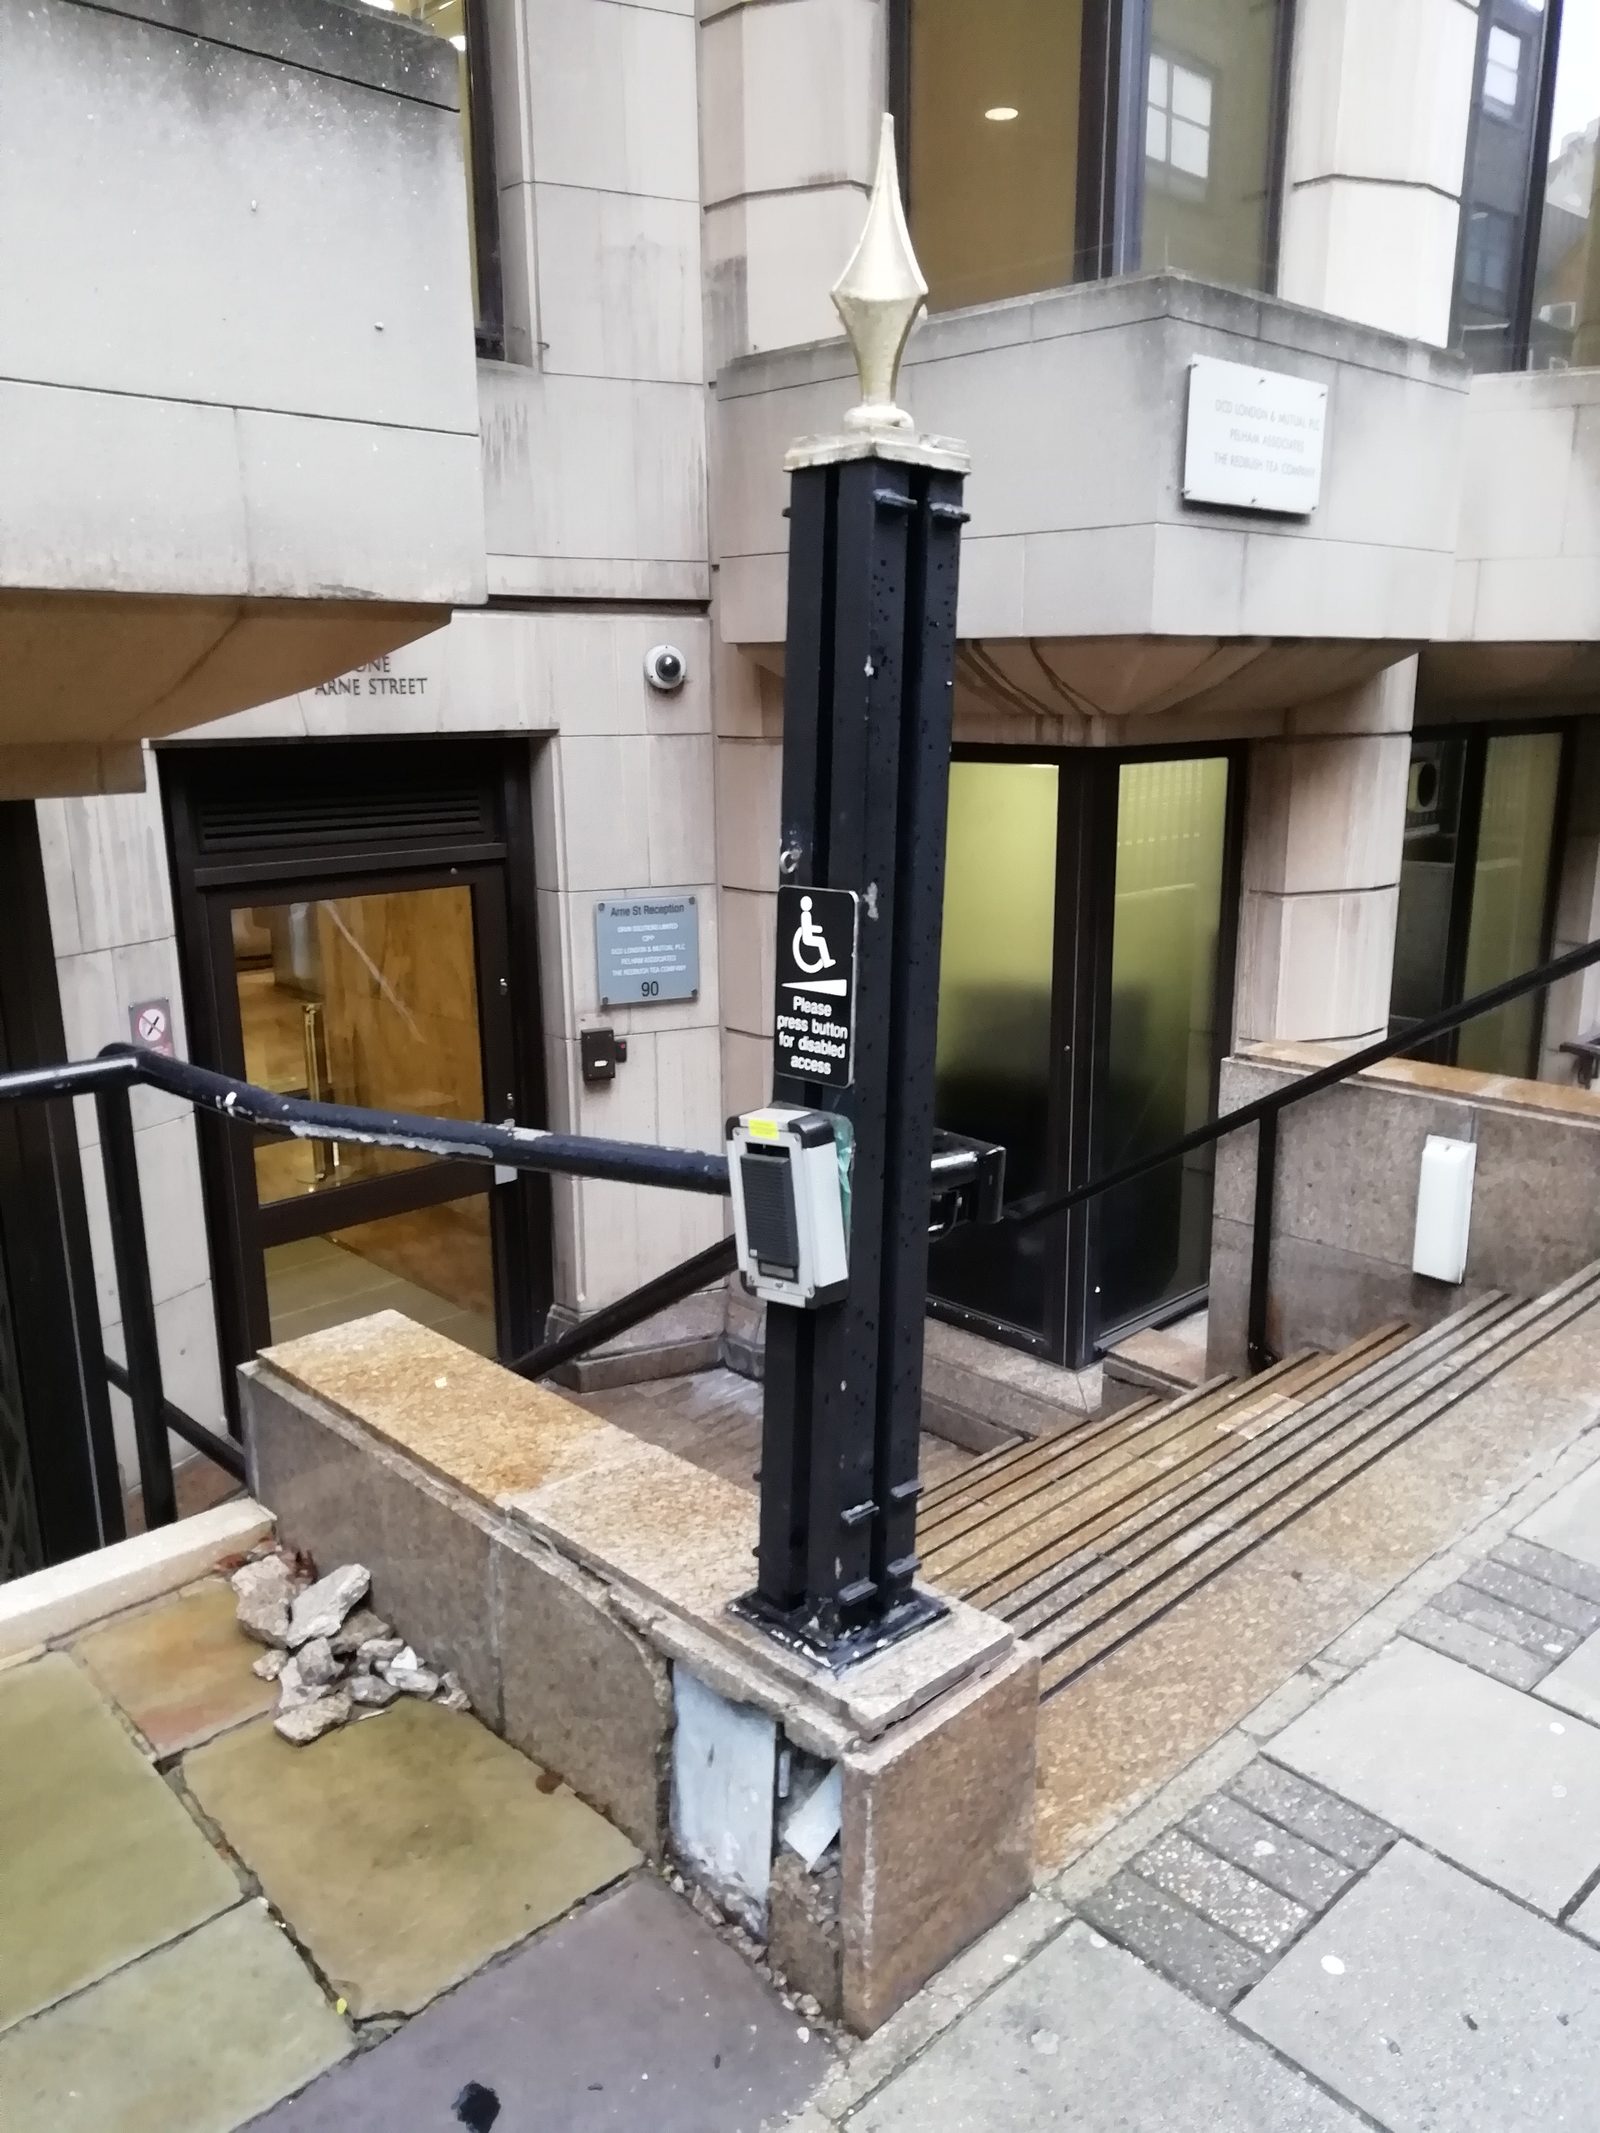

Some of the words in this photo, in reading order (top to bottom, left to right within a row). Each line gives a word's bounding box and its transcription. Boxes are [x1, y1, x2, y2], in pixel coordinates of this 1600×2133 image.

[1235, 403, 1268, 421] LONDON
[1214, 452, 1228, 466] THE
[315, 678, 361, 696] ARNE
[368, 677, 428, 695] STREET
[610, 907, 631, 917] Arne
[632, 905, 642, 916] St
[643, 904, 685, 916] Reception
[641, 980, 659, 997] 90
[793, 995, 832, 1017] Please
[777, 1015, 809, 1032] press
[811, 1018, 848, 1040] button
[778, 1031, 795, 1048] for
[798, 1035, 846, 1059] disabled
[790, 1055, 831, 1075] access
